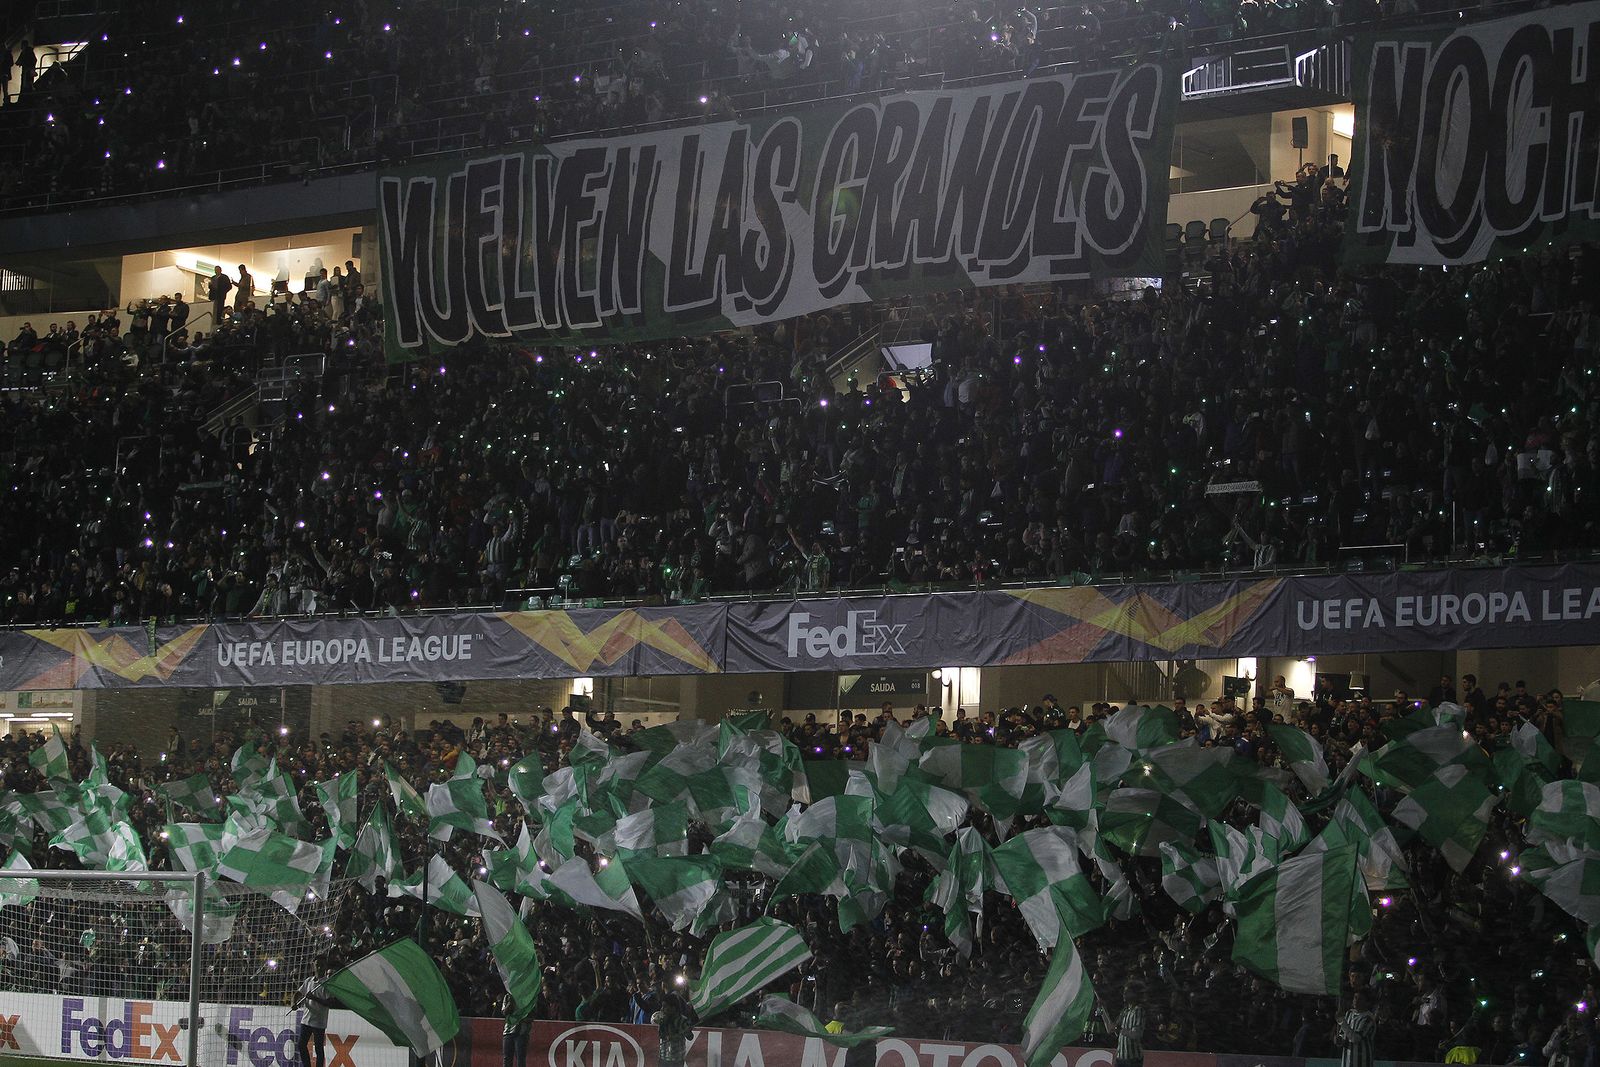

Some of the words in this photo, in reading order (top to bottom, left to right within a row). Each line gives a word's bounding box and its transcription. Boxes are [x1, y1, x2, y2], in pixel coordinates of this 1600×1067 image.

[380, 144, 661, 348] VUELVEN
[663, 115, 802, 312] LAS
[811, 63, 1163, 297] GRANDES
[787, 609, 907, 658] FedEx
[1297, 597, 1386, 631] UEFA
[1395, 591, 1532, 627] EUROPA
[217, 641, 277, 667] UEFA
[281, 638, 372, 665] EUROPA
[378, 634, 472, 662] LEAGUE
[870, 683, 896, 693] SALIDA
[61, 998, 182, 1062] FedEx
[226, 1006, 360, 1067] Fedx
